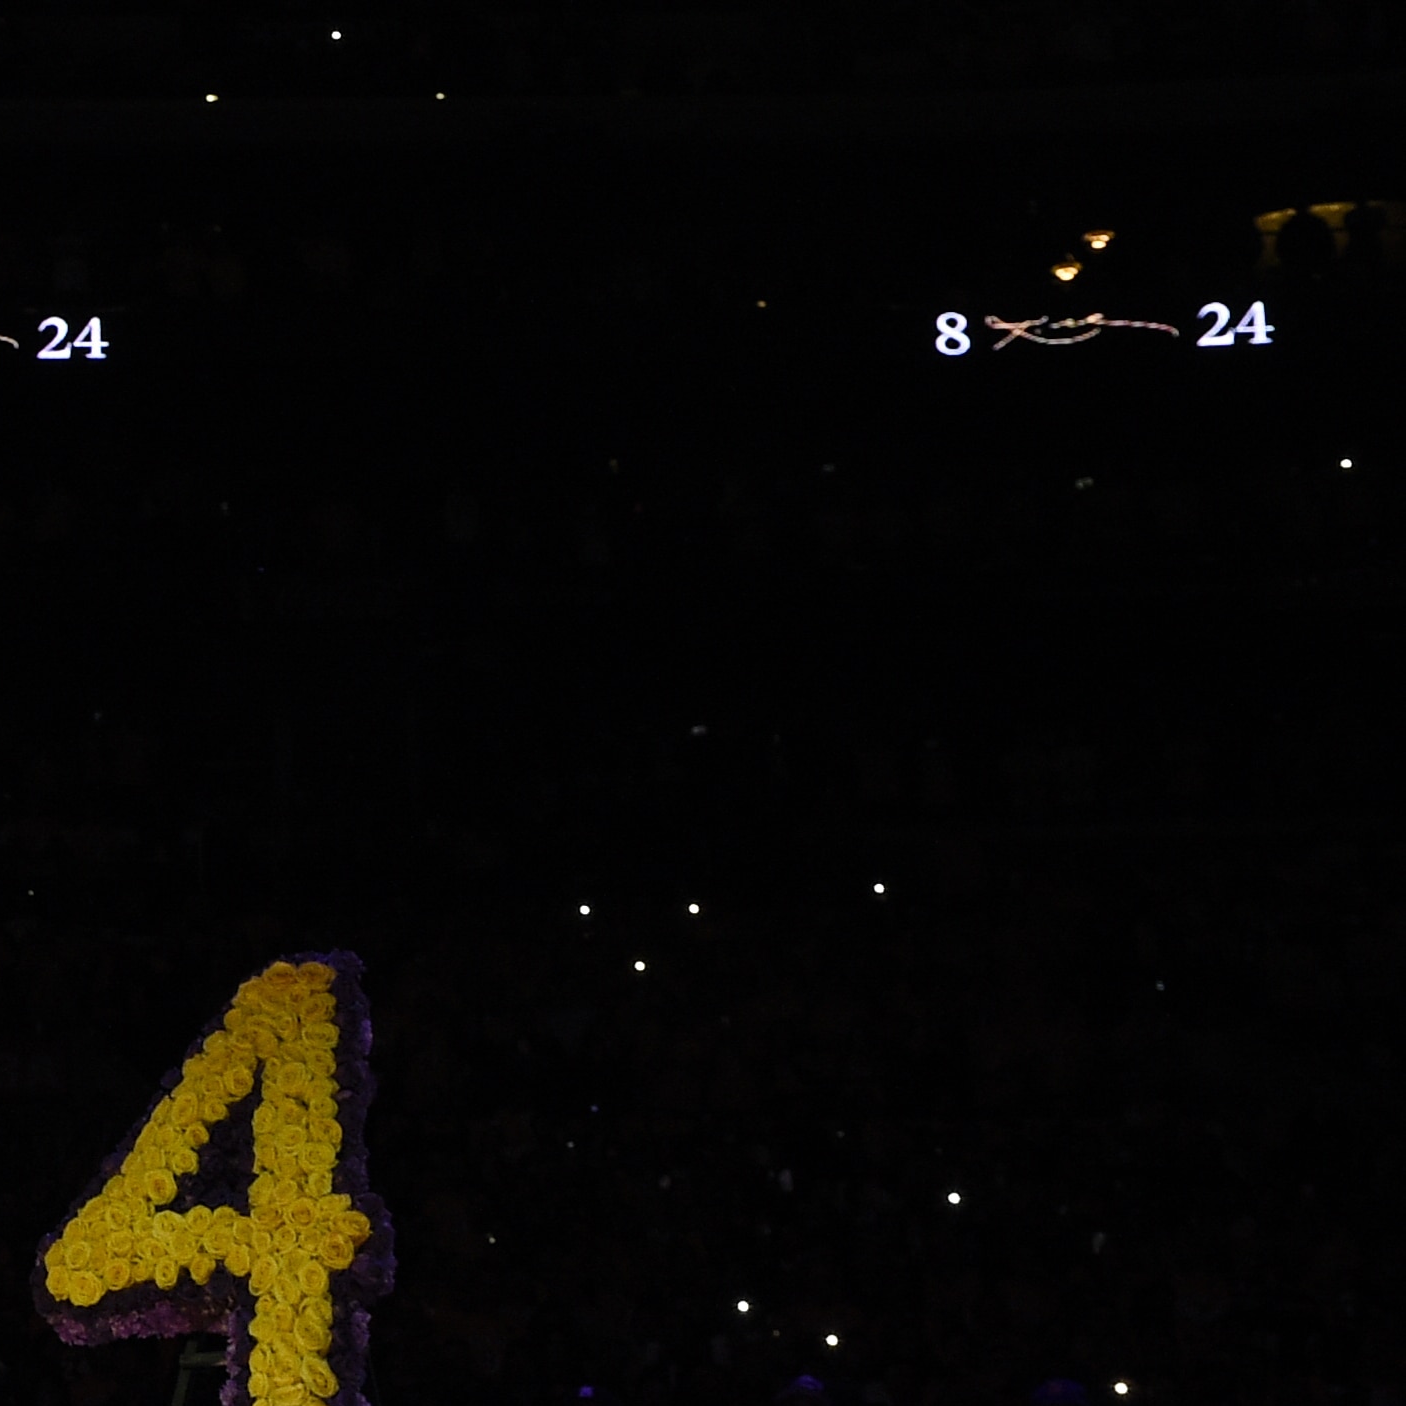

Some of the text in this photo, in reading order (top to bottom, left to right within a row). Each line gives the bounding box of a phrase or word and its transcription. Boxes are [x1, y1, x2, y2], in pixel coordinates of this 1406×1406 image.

[36, 316, 110, 360] 24
[934, 311, 971, 355] 8
[1196, 300, 1276, 348] 24
